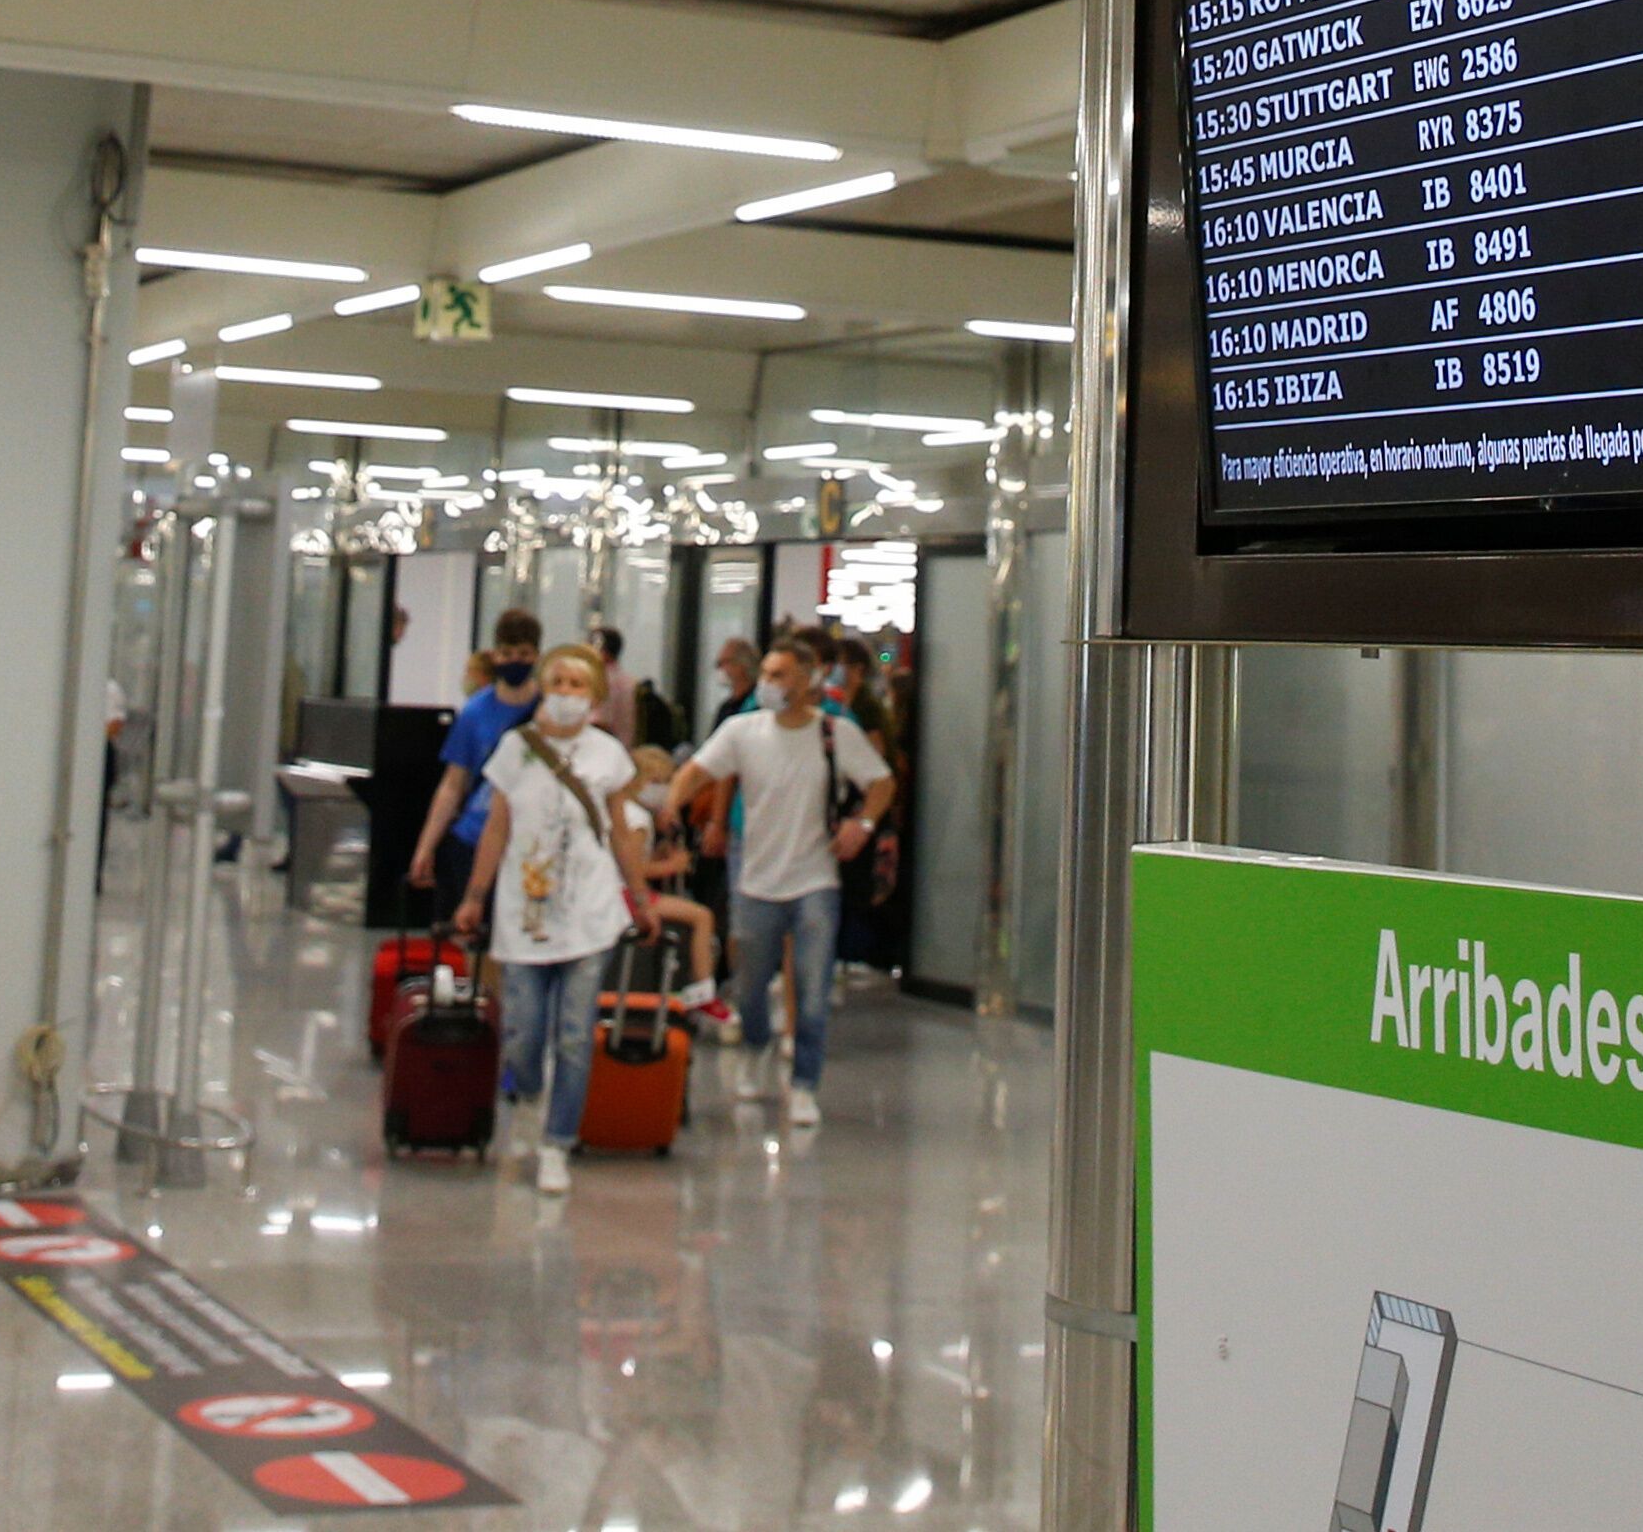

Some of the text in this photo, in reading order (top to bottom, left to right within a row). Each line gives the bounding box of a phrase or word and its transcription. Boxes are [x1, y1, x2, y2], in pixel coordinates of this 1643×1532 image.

[1196, 37, 1518, 140] 15:30 STUTTGART EWG 2586
[1206, 225, 1532, 303] 16:10 MENORCA IB 8491
[1213, 348, 1540, 411] 16:15 IBIZA IB 8519
[1221, 453, 1242, 481] Para
[1243, 456, 1272, 486] mayor
[1273, 446, 1318, 479] eficiencia
[1318, 443, 1369, 482] operativa,
[1369, 448, 1384, 473] en
[1383, 438, 1423, 472] horario
[1423, 437, 1476, 473] nocturno,
[1477, 433, 1521, 473] algunas
[1522, 429, 1567, 470] puertas
[1568, 426, 1584, 460] de
[1584, 422, 1631, 466] llegada
